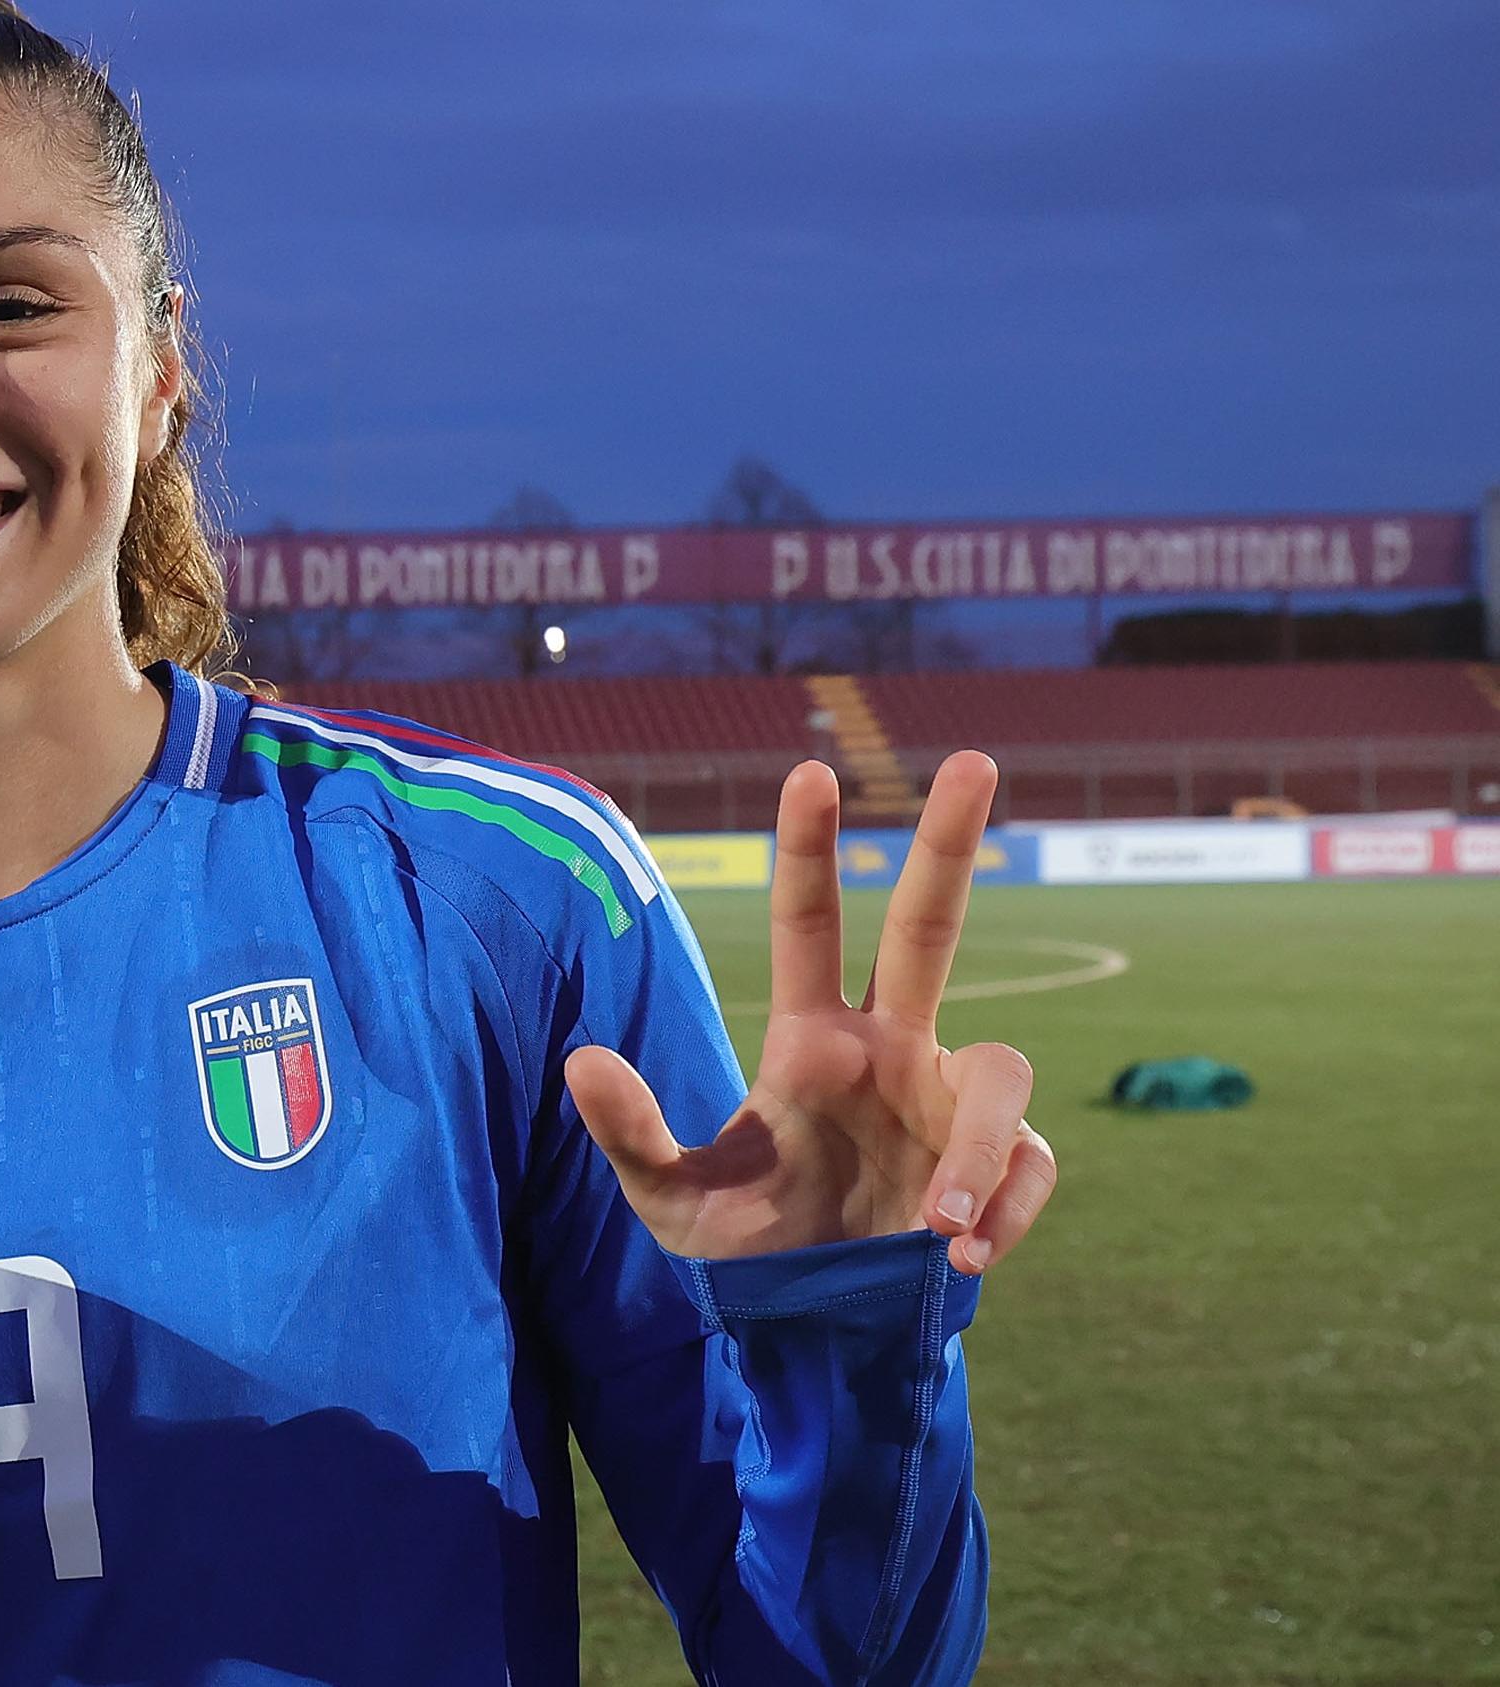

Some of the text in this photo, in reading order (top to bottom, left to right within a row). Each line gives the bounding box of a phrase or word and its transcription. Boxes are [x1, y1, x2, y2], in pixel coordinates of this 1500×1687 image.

[302, 545, 349, 607] DI
[1047, 528, 1097, 593] DI
[200, 993, 308, 1044] ITALIA
[242, 1035, 274, 1053] FIGC
